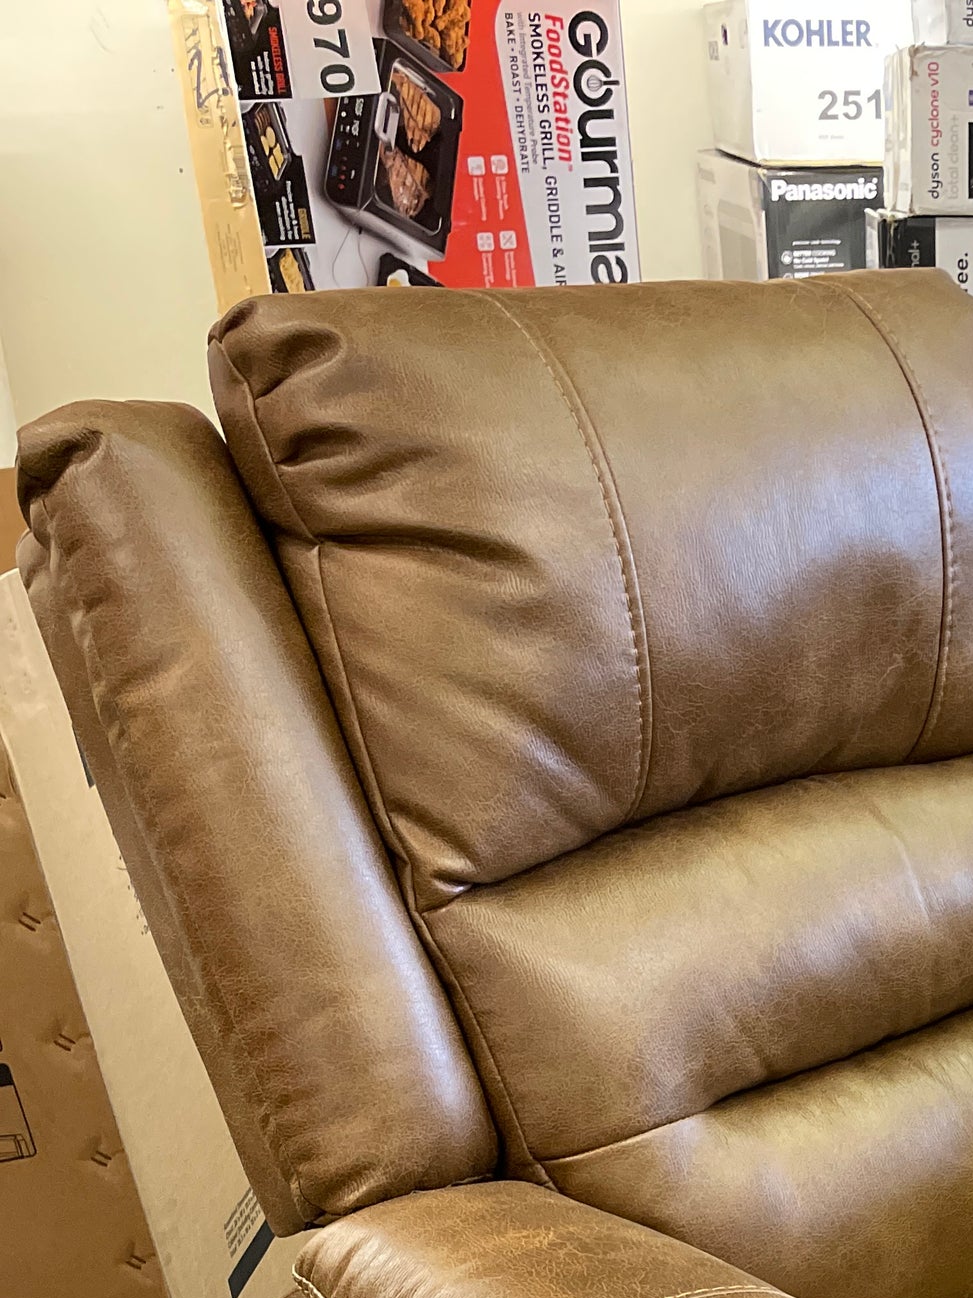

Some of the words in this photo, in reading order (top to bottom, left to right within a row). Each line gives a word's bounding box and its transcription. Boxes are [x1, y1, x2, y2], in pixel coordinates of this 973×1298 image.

[504, 12, 516, 45] BAKE
[763, 18, 873, 48] KOHLER
[509, 55, 522, 95] ROAST
[528, 12, 550, 114] SMOKELESS
[927, 62, 940, 87] v10
[817, 89, 883, 121] 251
[927, 90, 943, 147] cyclone
[514, 105, 530, 174] DEHYDRATE
[539, 119, 555, 170] GRILL,
[568, 10, 628, 285] Gourmia
[770, 177, 878, 202] Panasonic
[927, 152, 943, 199] dyson
[545, 175, 562, 243] GRIDDLE
[552, 247, 564, 258] &
[957, 253, 968, 293] ee.
